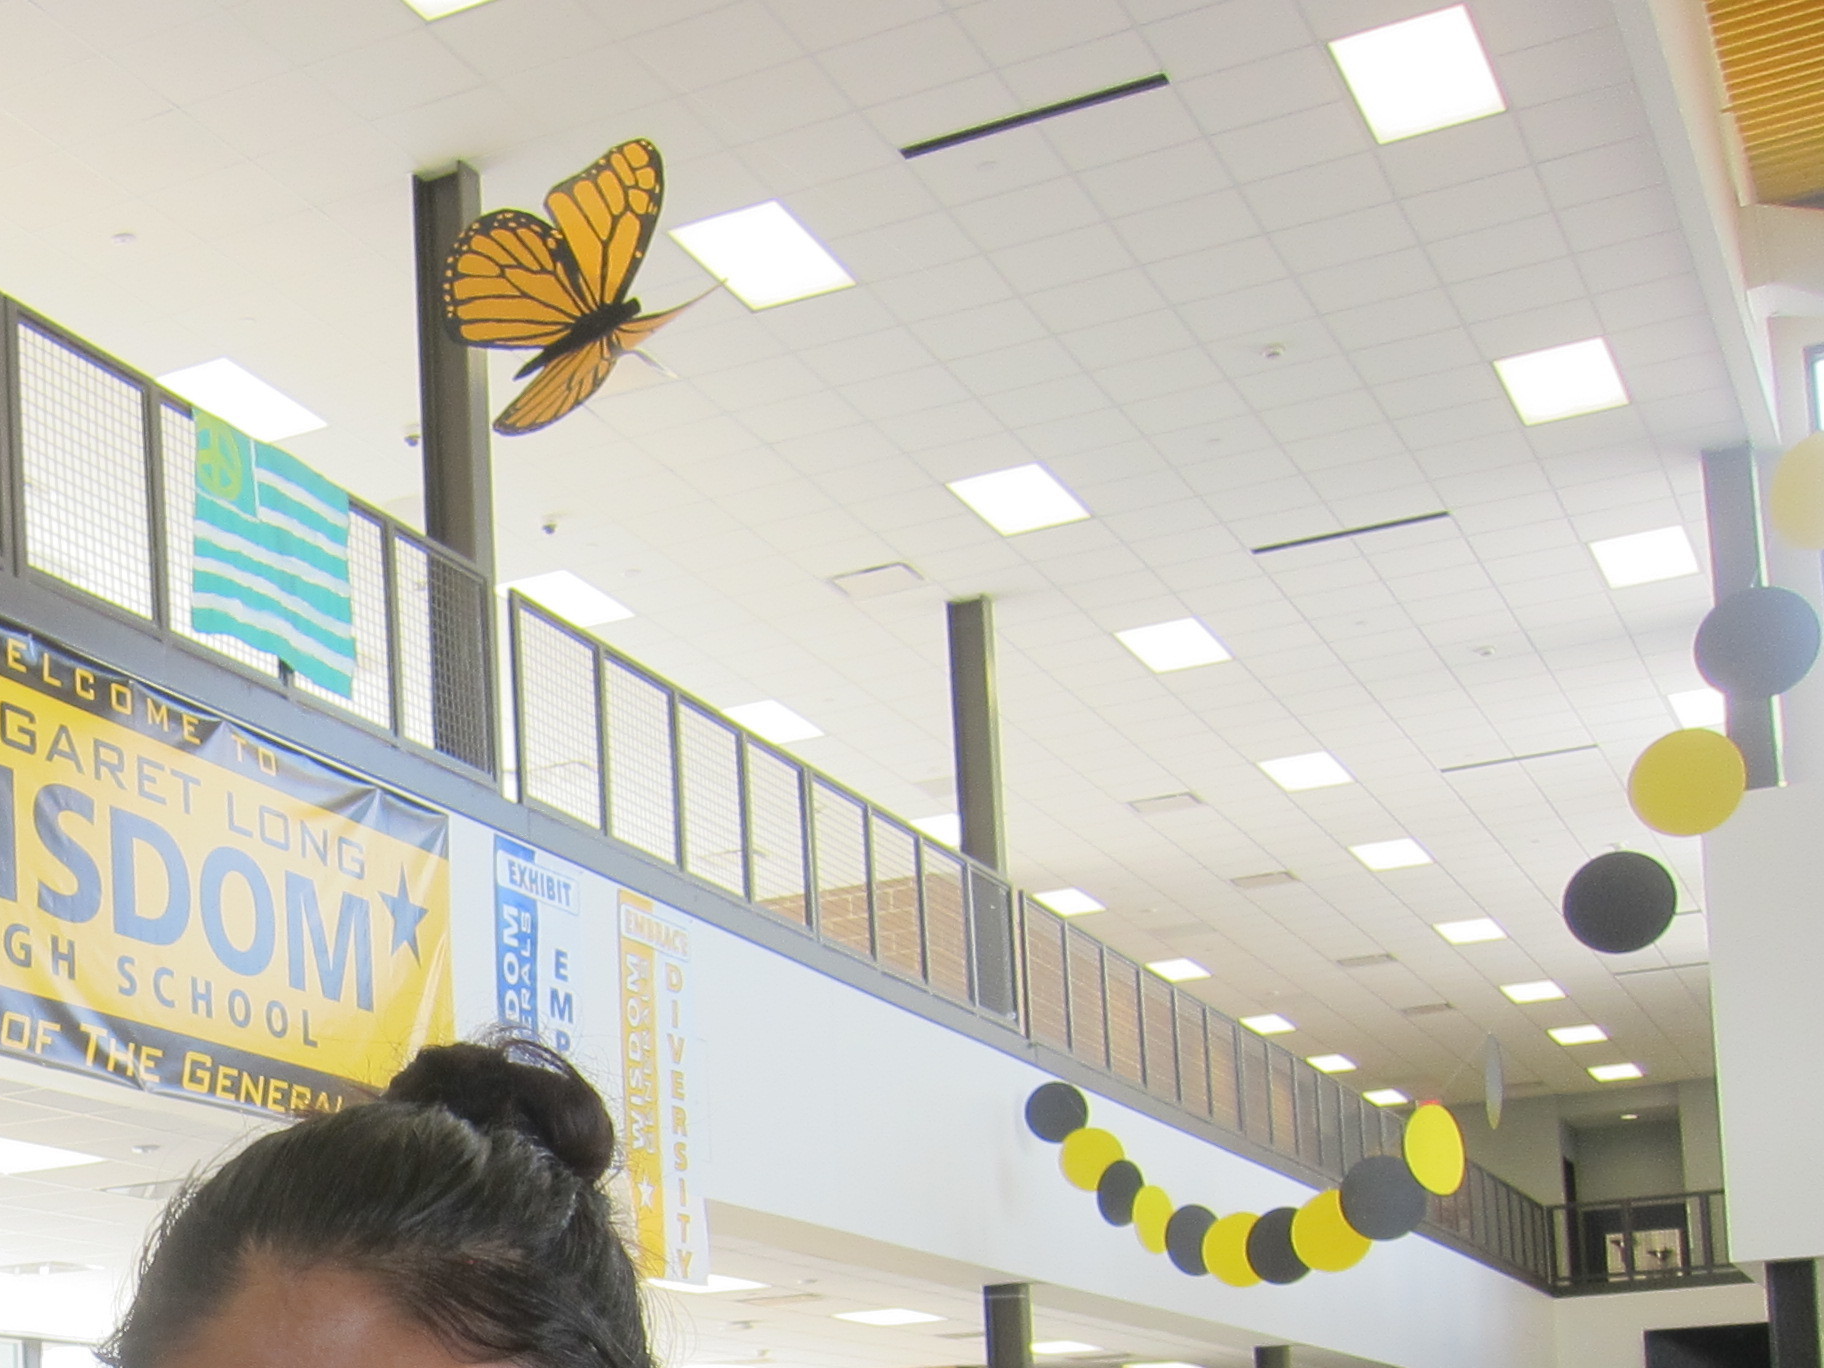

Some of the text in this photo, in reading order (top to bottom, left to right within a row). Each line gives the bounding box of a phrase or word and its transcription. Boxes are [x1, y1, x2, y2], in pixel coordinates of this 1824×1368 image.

[231, 733, 279, 777] TO
[226, 790, 367, 882] LONG
[507, 858, 572, 908] EXHIBIT
[115, 954, 319, 1049] SCHOOL
[625, 953, 645, 1150] WISDOM
[664, 962, 693, 1280] DIVERSITY
